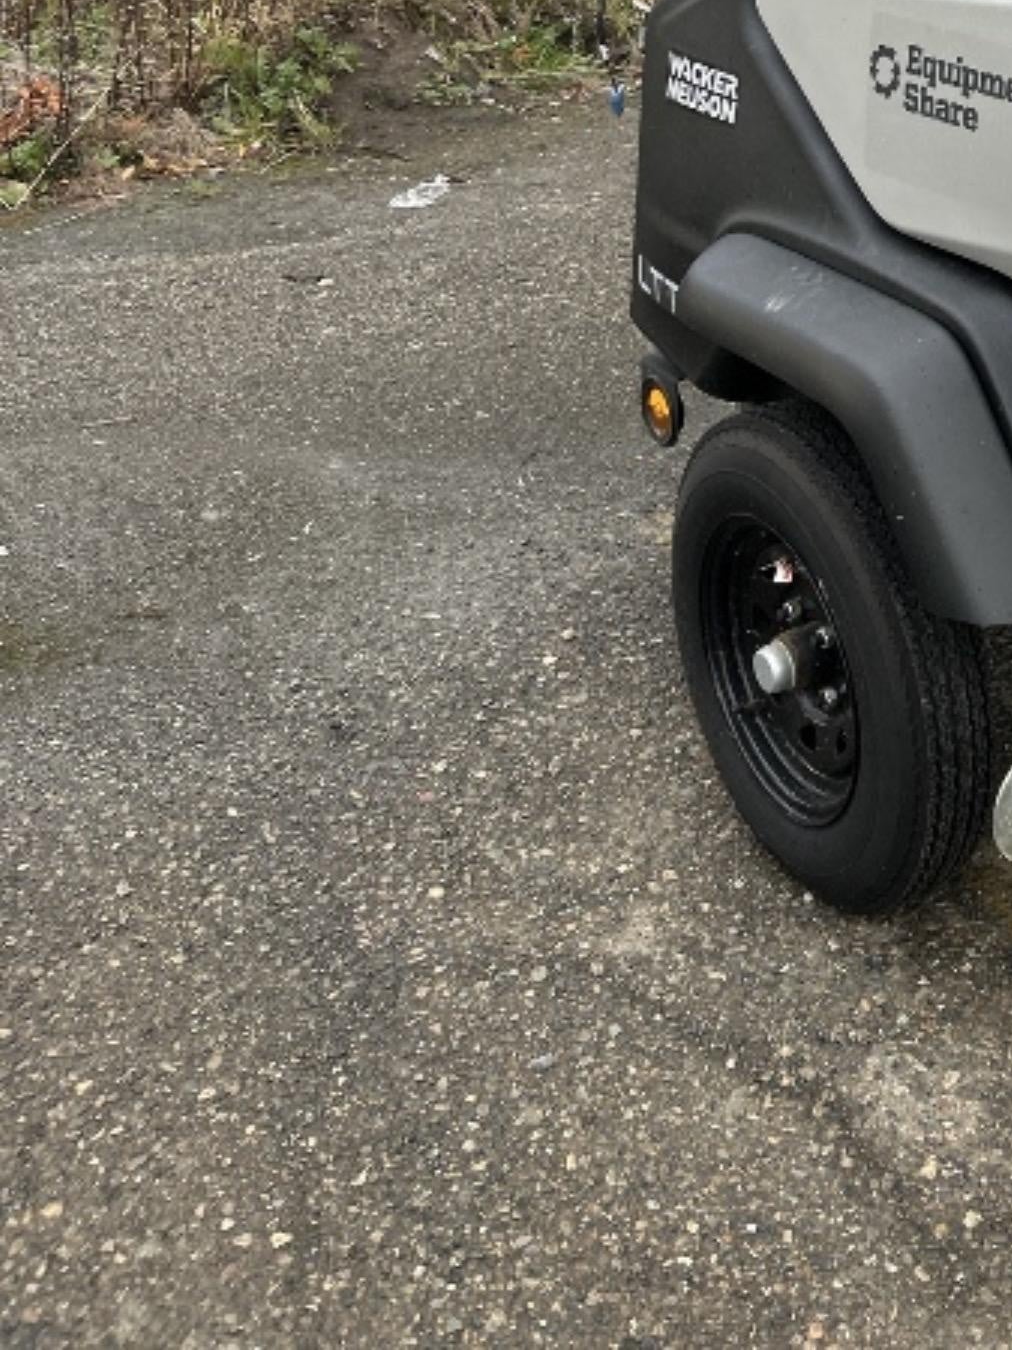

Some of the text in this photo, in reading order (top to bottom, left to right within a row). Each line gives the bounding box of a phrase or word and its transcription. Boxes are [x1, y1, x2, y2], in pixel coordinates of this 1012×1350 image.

[665, 76, 739, 124] NEUSON
[667, 50, 739, 100] WACKER
[903, 82, 979, 133] Share
